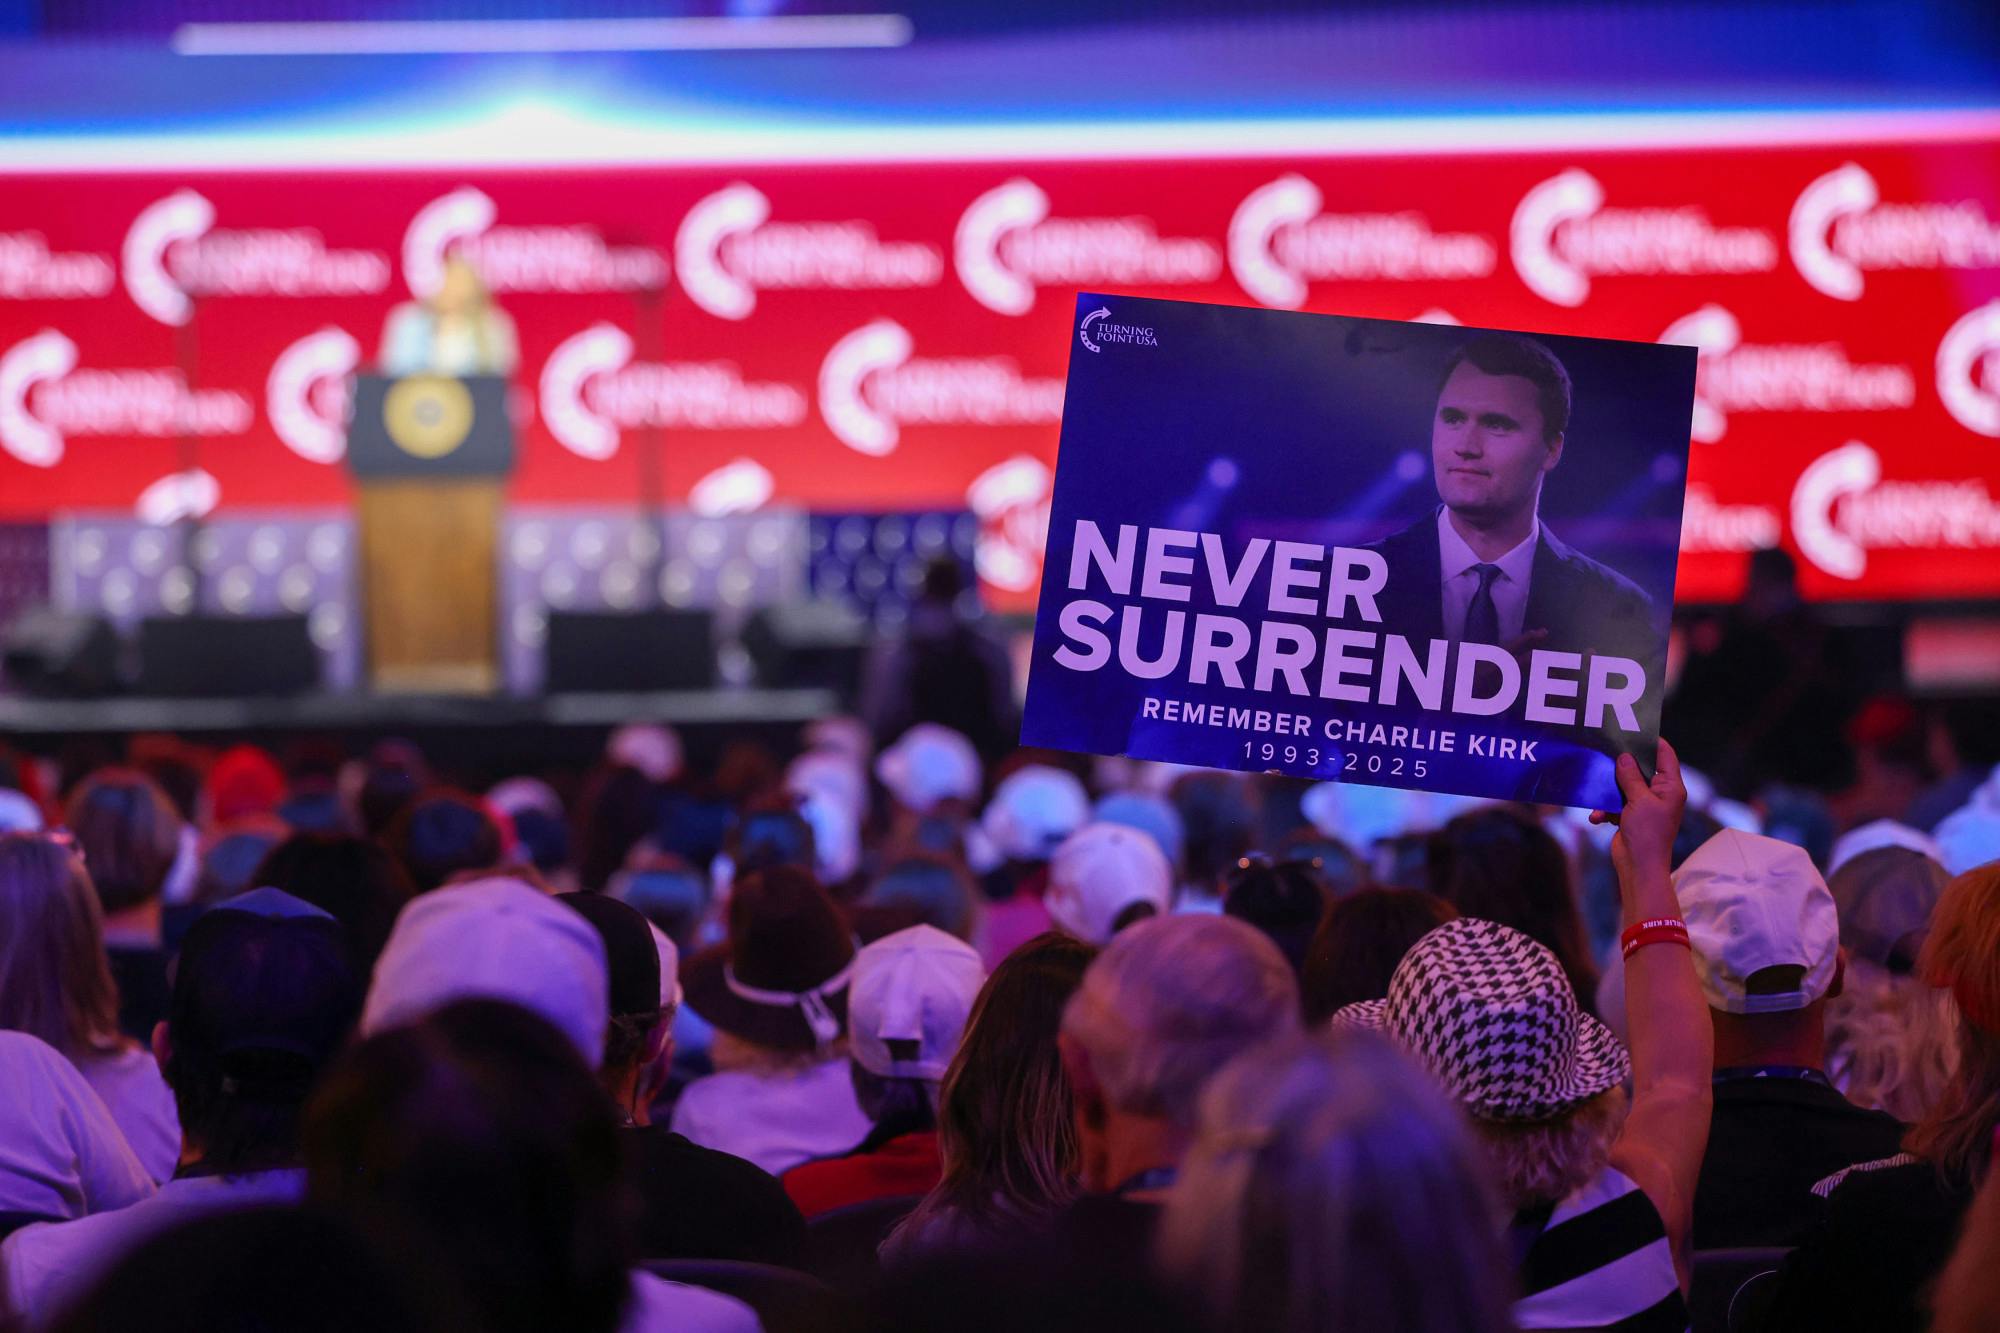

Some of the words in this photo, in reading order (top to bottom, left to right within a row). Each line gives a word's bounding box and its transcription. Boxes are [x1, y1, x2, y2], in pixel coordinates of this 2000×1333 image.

[1097, 323, 1154, 337] TURNING
[1097, 332, 1135, 343] POINT
[1136, 336, 1158, 346] USA
[1067, 519, 1389, 623] NEVER
[1052, 599, 1647, 733] SURRENDER
[1142, 697, 1312, 737] REMEMBER
[1324, 718, 1456, 753] CHARLIE
[1467, 734, 1539, 762] KIRK
[1243, 741, 1427, 778] 1993-2025
